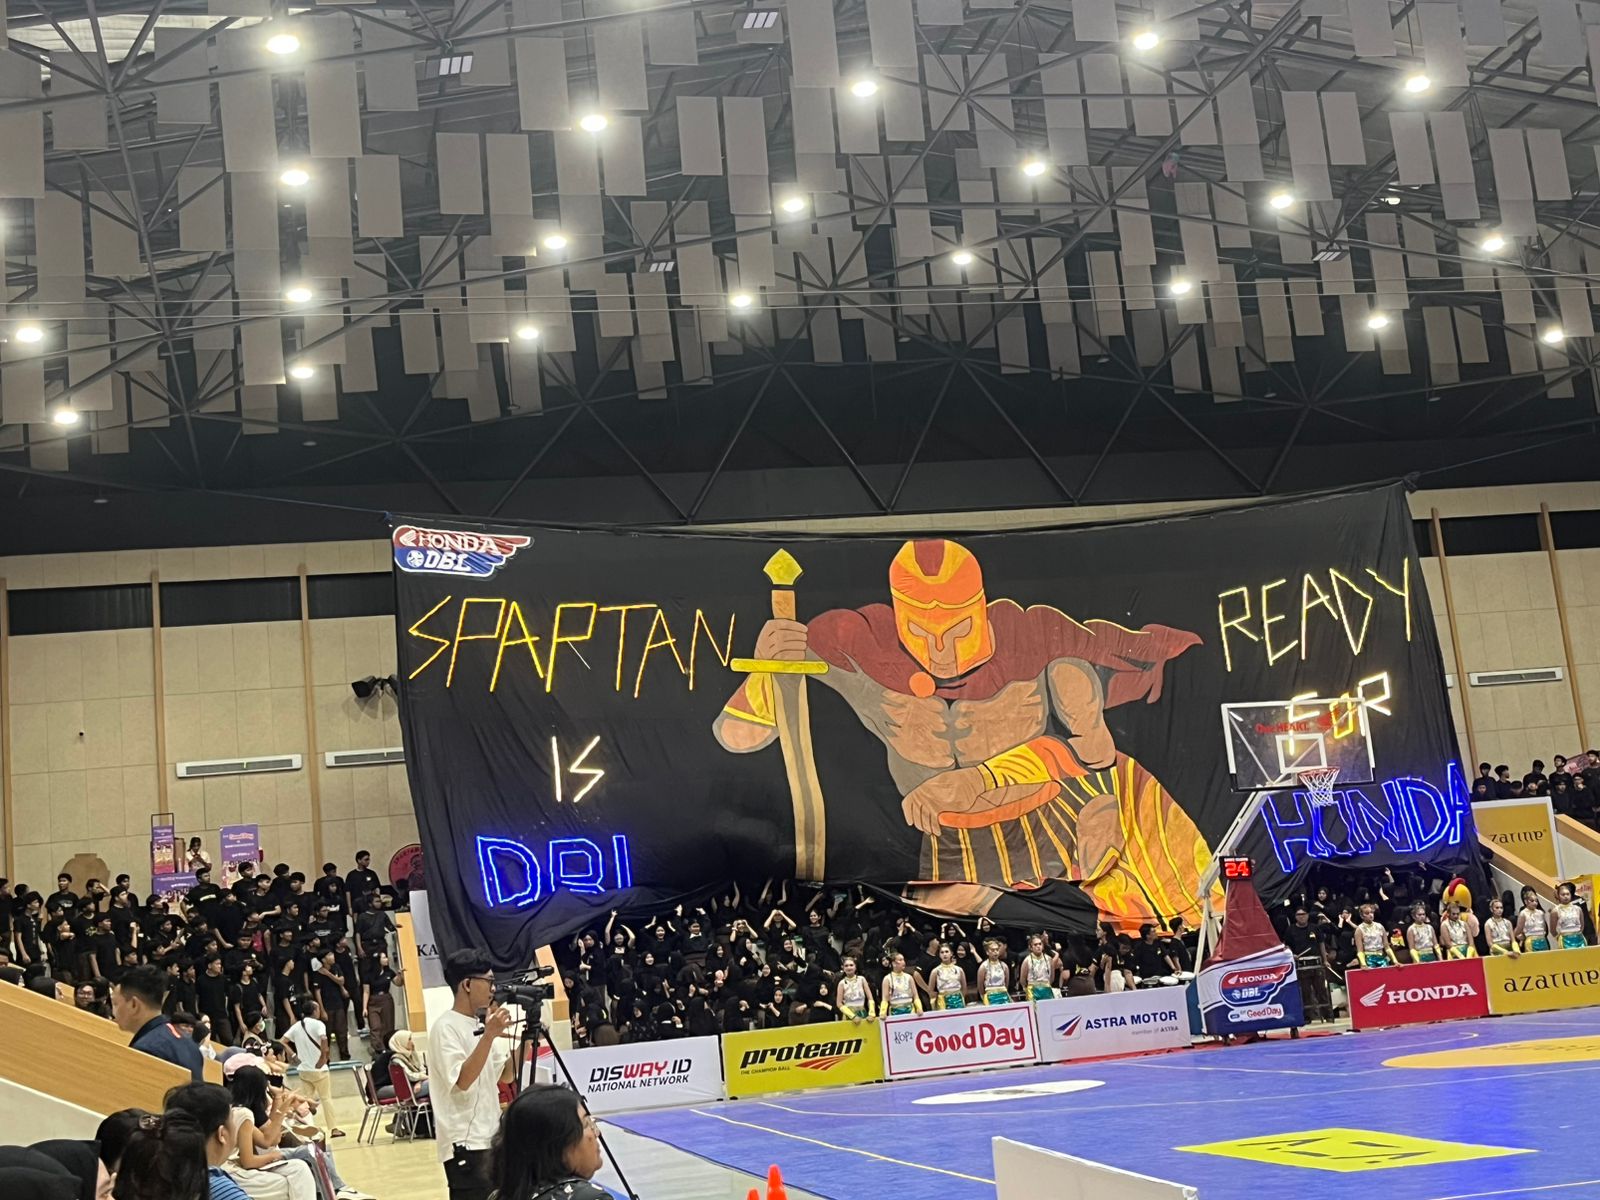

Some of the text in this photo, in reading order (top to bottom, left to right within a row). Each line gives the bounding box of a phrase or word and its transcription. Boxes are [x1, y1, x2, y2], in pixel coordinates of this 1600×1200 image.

[418, 532, 501, 555] HONDA
[424, 550, 471, 572] DBL
[1218, 557, 1412, 672] READY
[408, 595, 736, 698] SPARTAN
[1287, 672, 1392, 756] FOR
[551, 736, 605, 803] IS
[1261, 763, 1470, 873] HONDA
[1488, 830, 1543, 844] zarine
[1224, 862, 1249, 876] 24
[416, 944, 438, 957] KA
[1239, 973, 1277, 984] HONDA
[1503, 970, 1600, 992] azarine
[1241, 987, 1261, 998] DBL
[1386, 983, 1477, 1005] HONDA
[1085, 1011, 1178, 1030] ASTRA MOTOR
[1160, 1025, 1179, 1033] ASTRA
[740, 1038, 863, 1069] proteam
[589, 1058, 692, 1083] DISWAY.ID
[587, 1074, 689, 1093] NATIONAL NETWORK
